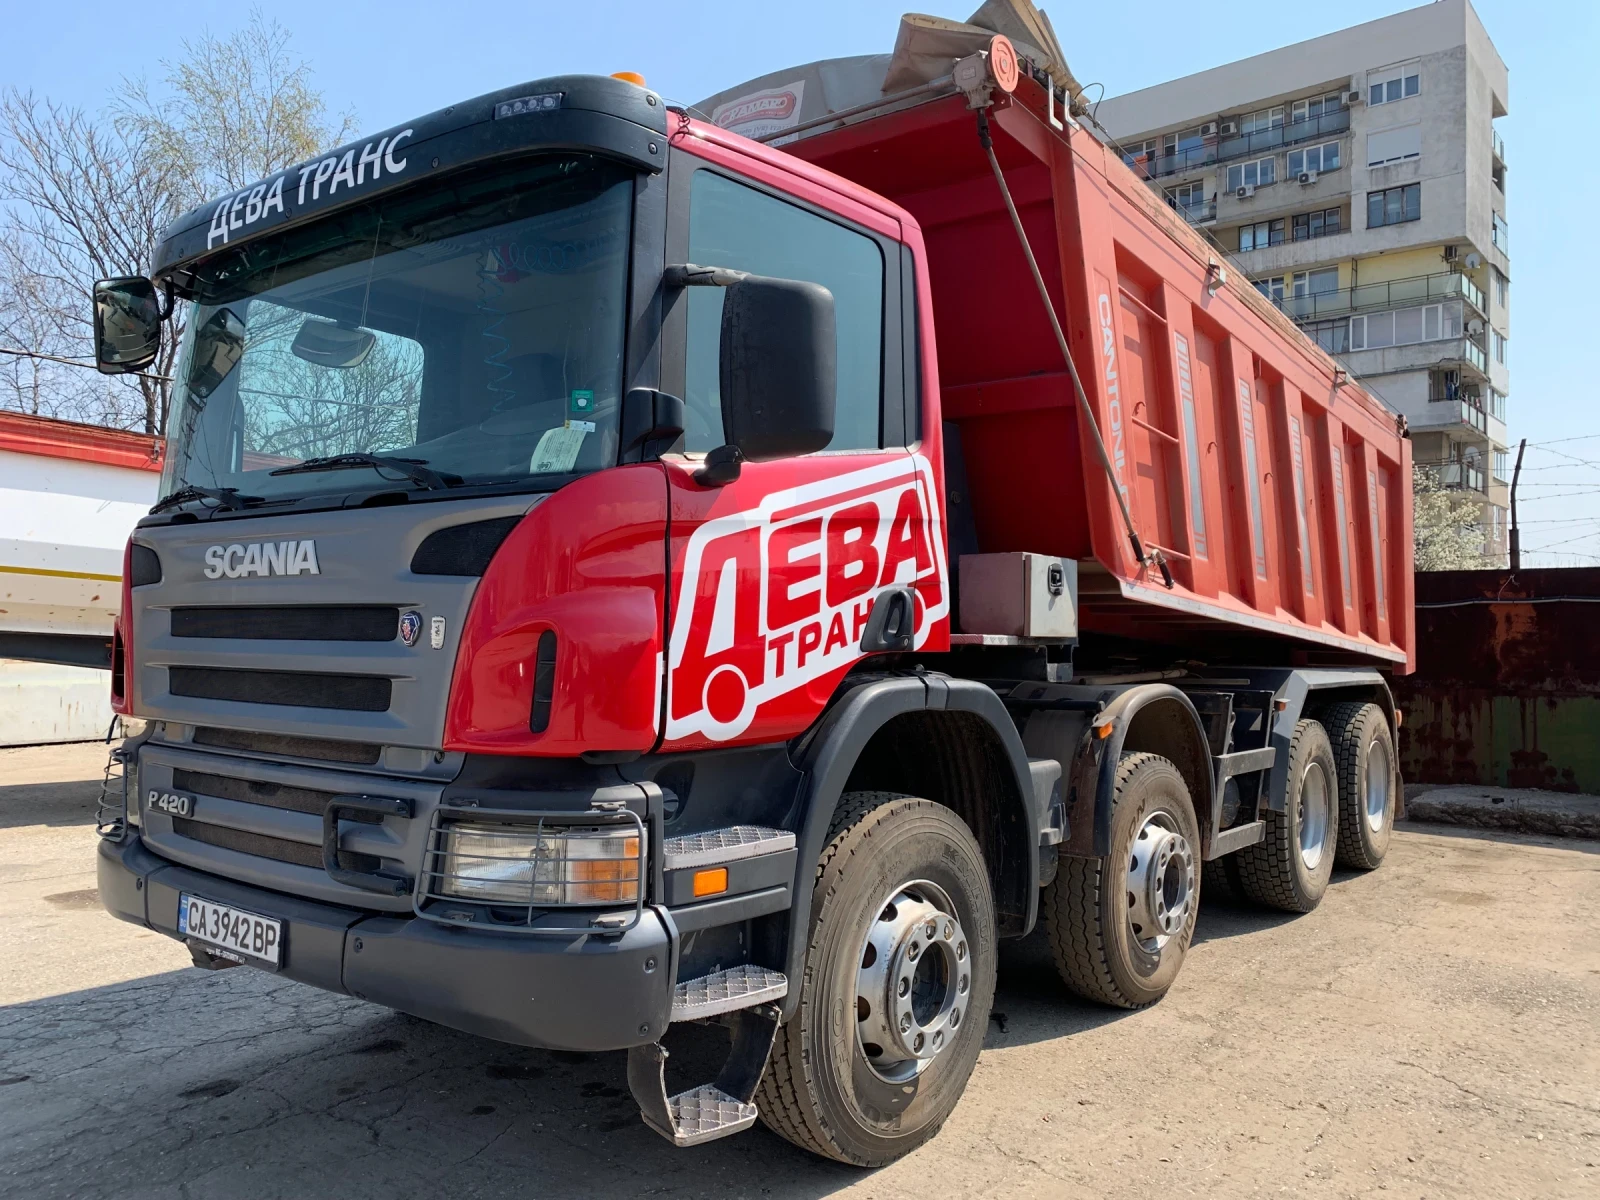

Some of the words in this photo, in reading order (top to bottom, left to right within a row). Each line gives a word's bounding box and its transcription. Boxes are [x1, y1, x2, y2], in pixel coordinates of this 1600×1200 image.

[207, 175, 285, 251] ДЕВА
[297, 128, 414, 205] ТРАНС
[203, 539, 321, 579] SCANIA
[671, 487, 933, 720] ДЕВА
[768, 597, 876, 679] ТРАН
[148, 790, 159, 808] P
[158, 793, 190, 815] 420
[188, 901, 207, 937] CA
[210, 908, 251, 951] 3942
[252, 920, 277, 957] BP
